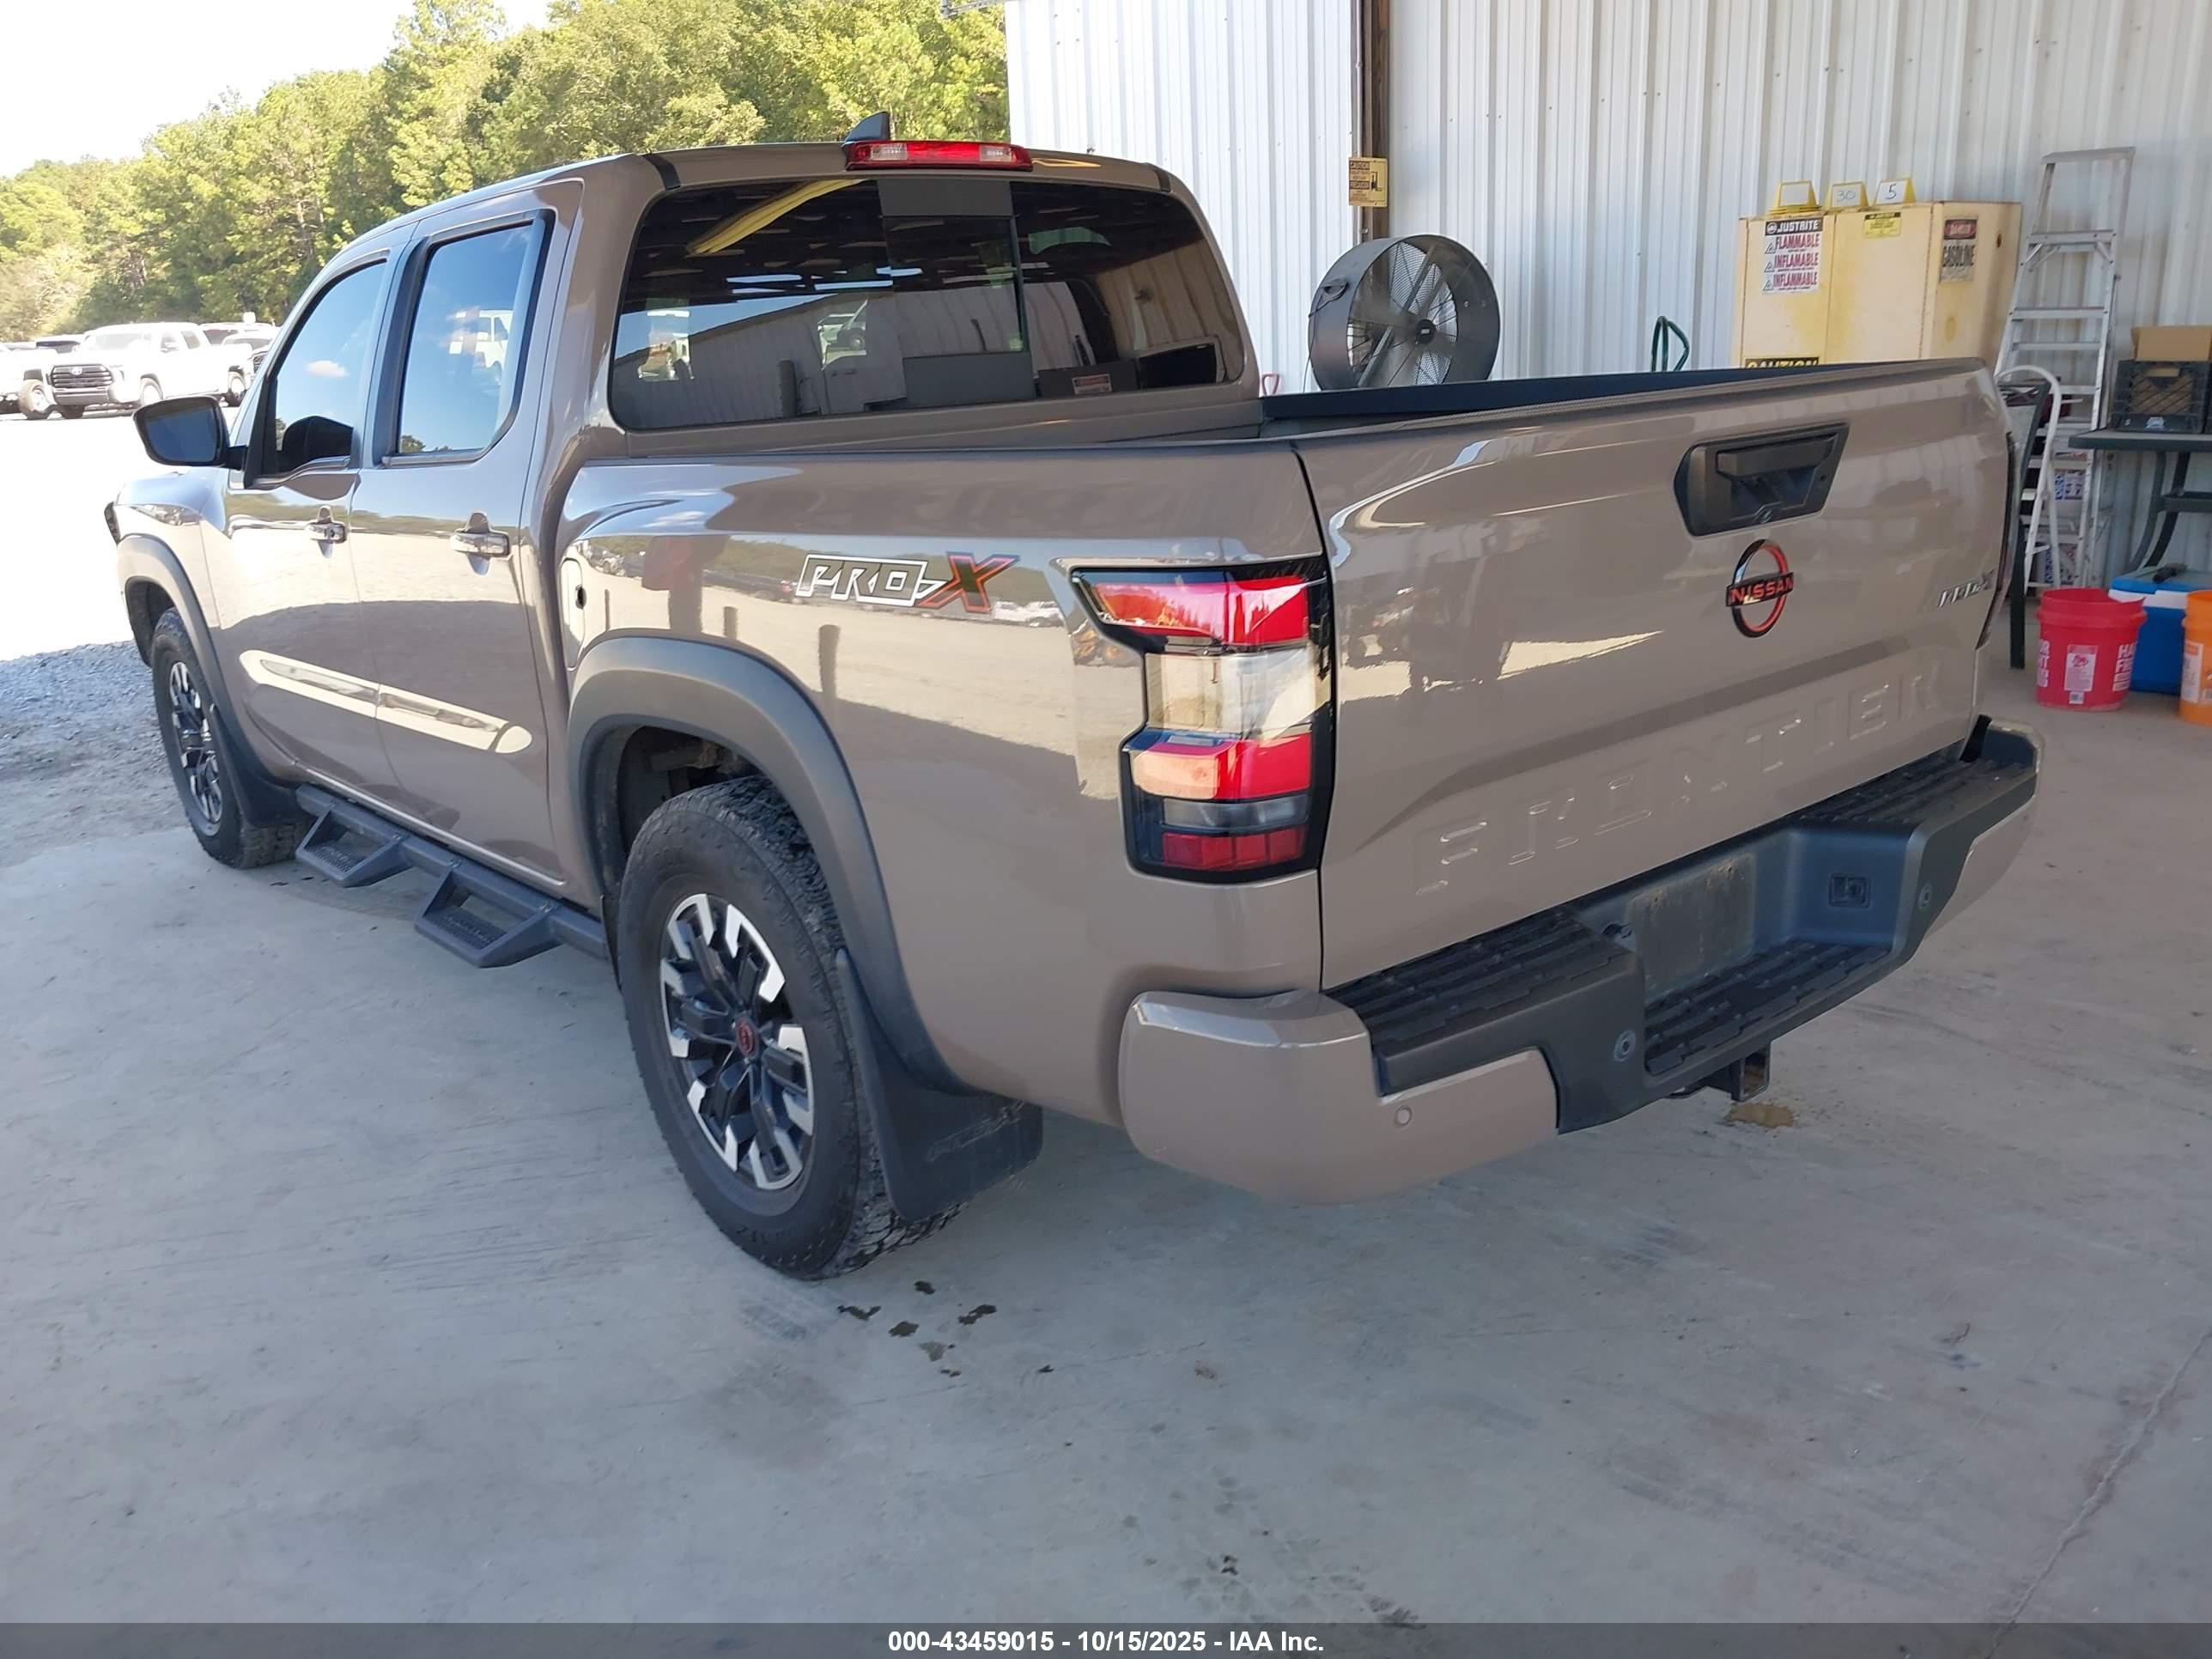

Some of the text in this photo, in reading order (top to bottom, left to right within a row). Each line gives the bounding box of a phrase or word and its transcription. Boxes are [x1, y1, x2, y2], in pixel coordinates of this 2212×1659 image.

[1884, 183, 1897, 200] 5
[1777, 220, 1820, 232] JUSTRITE
[1774, 233, 1820, 251] FLAMMABLE
[1729, 577, 1794, 604] NISSAN
[1414, 669, 1942, 897] FRONTIER
